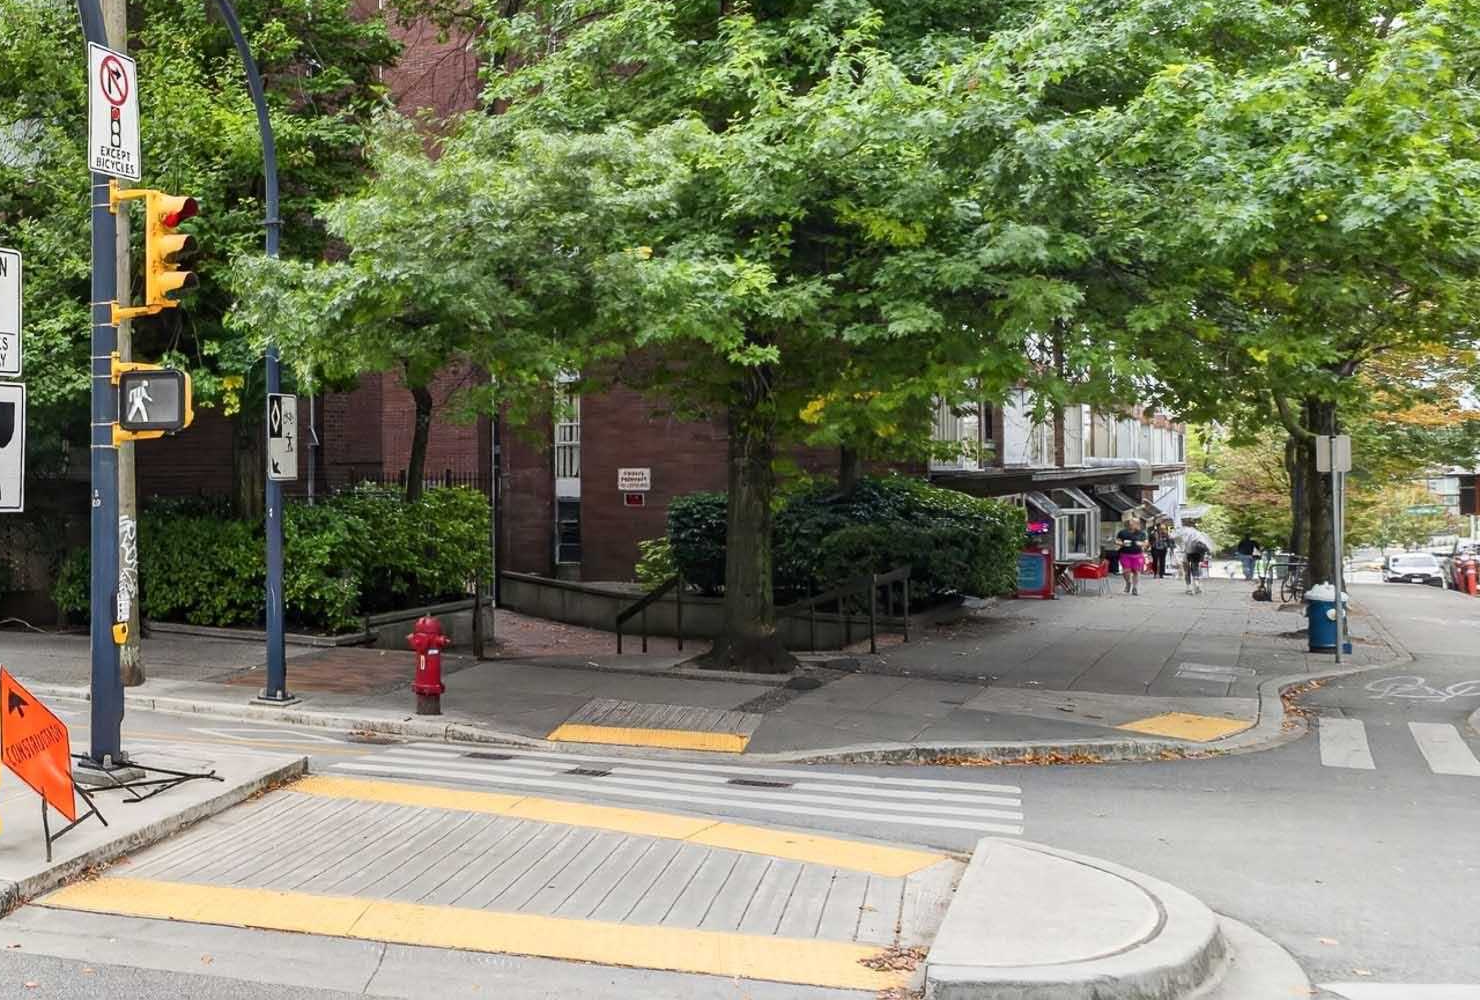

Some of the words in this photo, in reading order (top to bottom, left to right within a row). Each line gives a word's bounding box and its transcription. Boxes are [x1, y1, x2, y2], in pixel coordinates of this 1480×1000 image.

[100, 146, 131, 162] EXCEPT
[96, 156, 135, 175] BICYCLES
[6, 724, 64, 767] CONSTRUCTION
